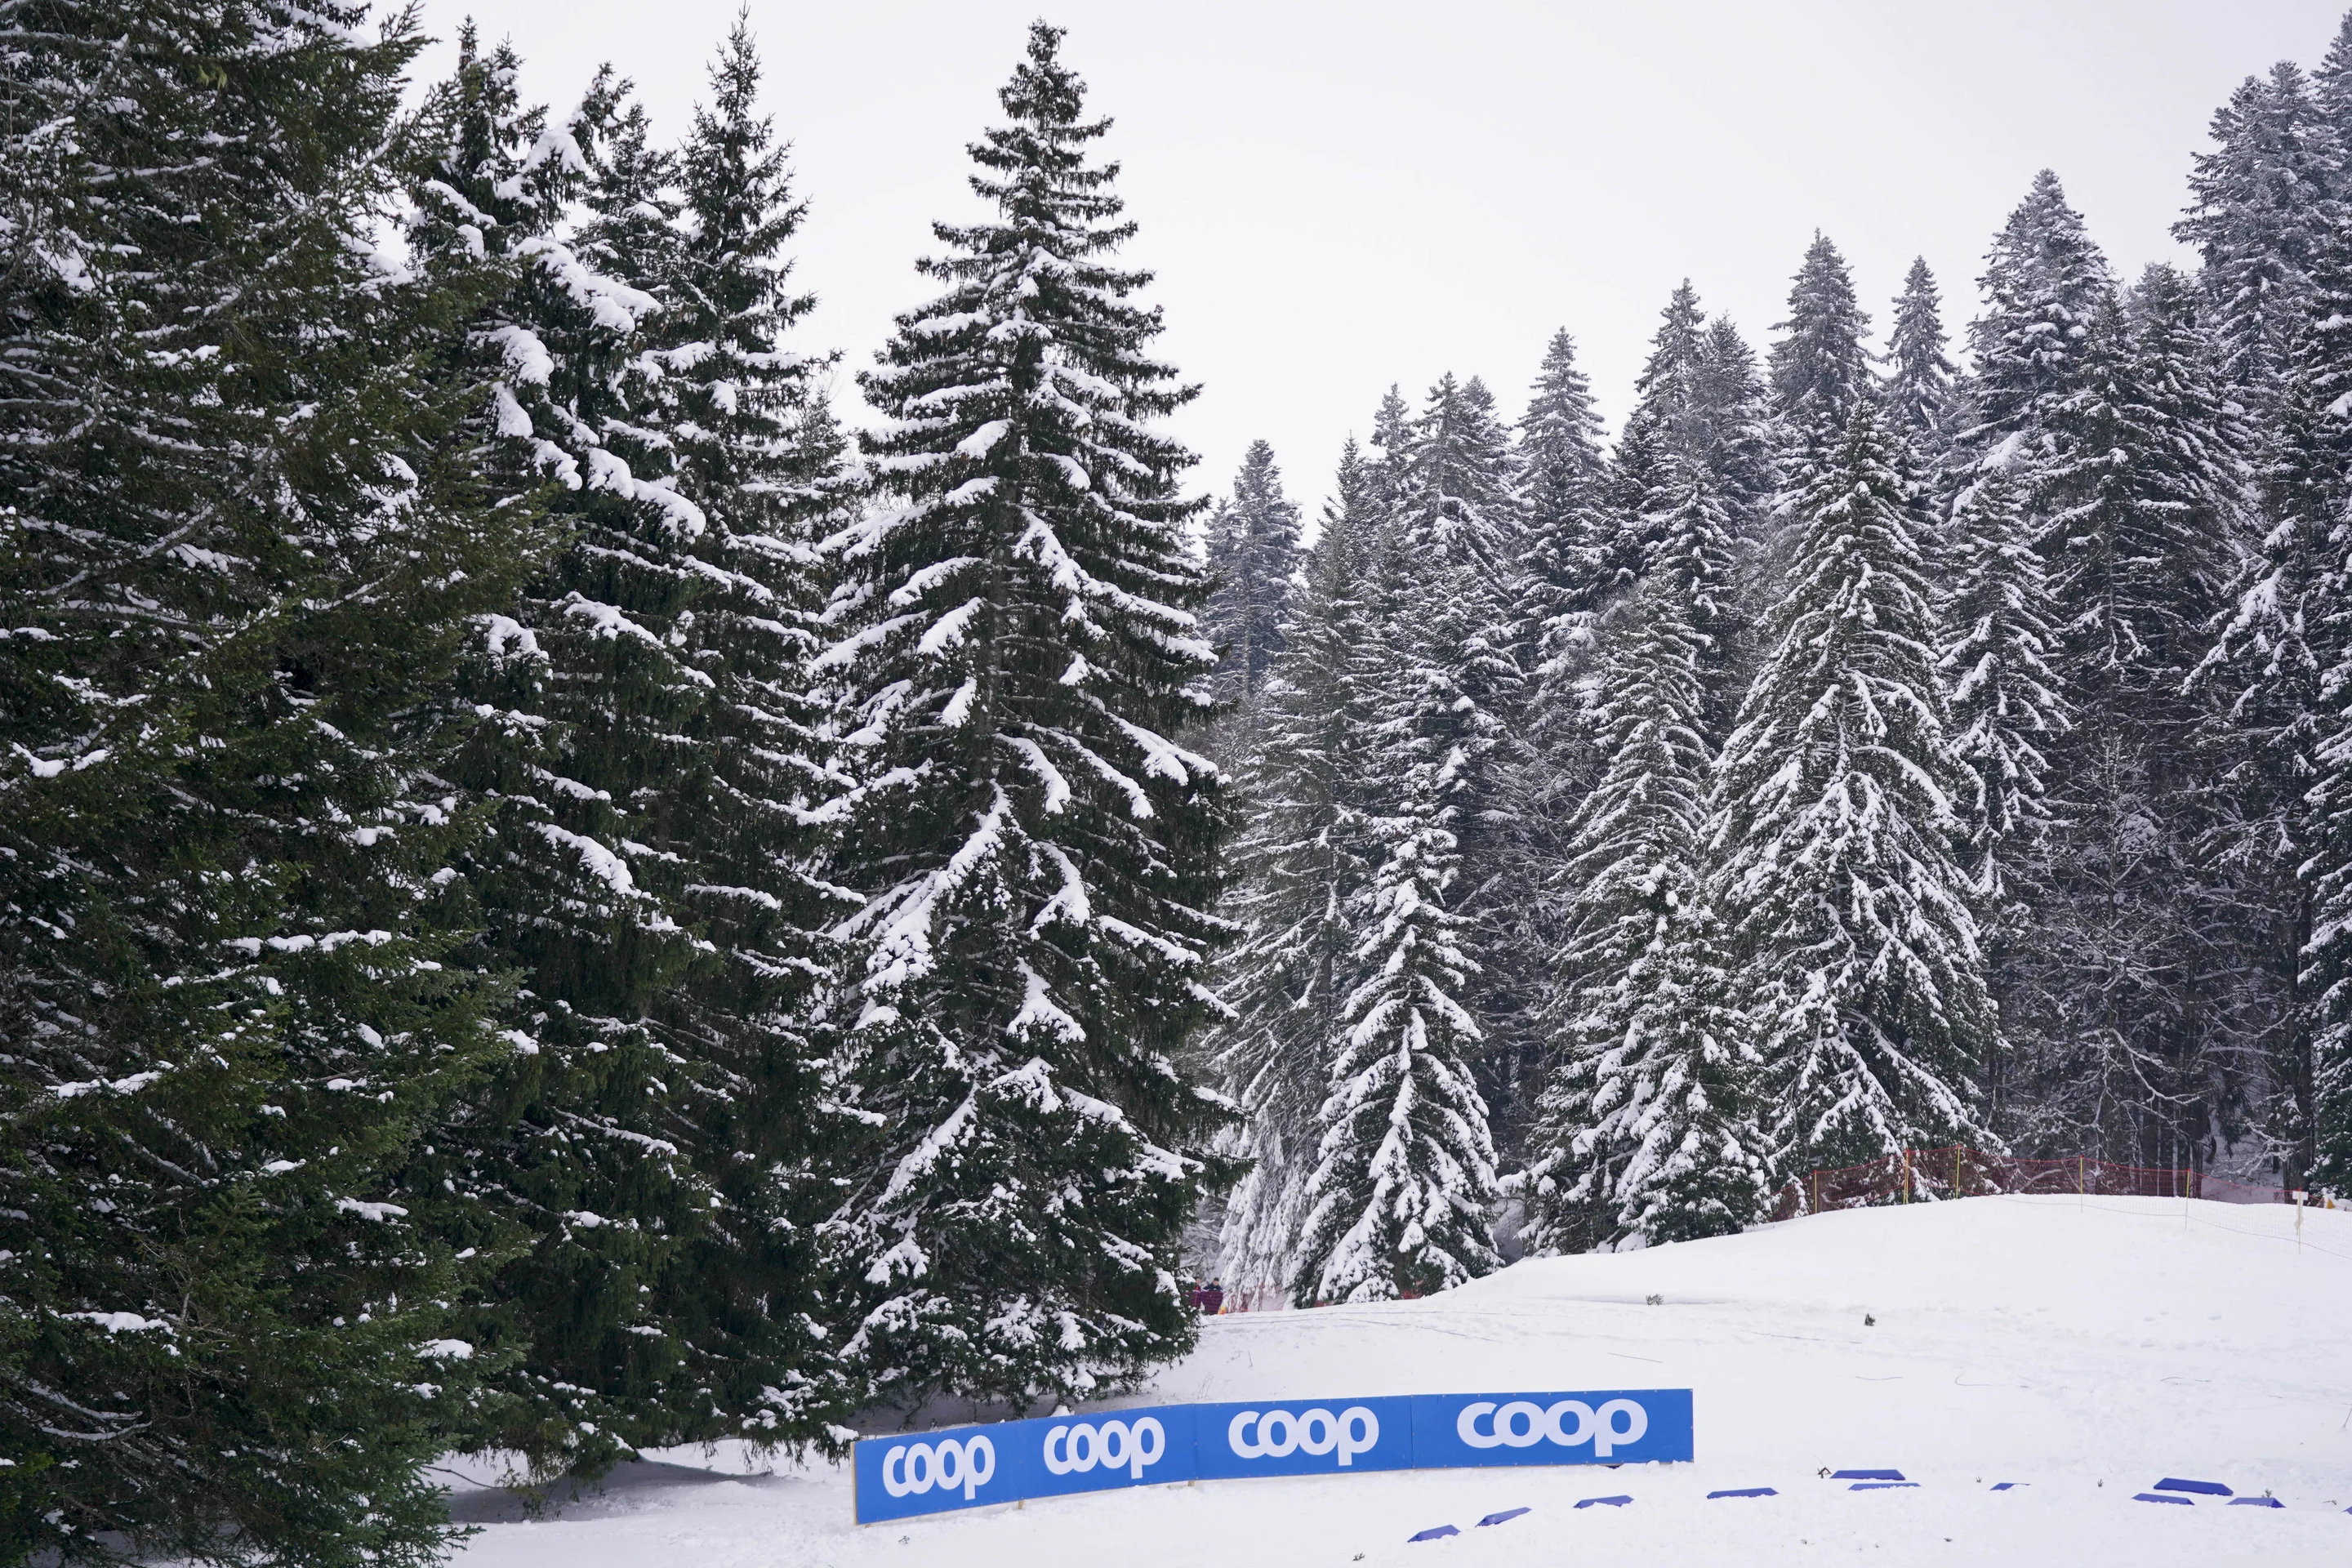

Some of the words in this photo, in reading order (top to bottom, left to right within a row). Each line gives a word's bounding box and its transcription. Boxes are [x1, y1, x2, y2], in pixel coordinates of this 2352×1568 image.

[1043, 1416, 1165, 1480] coop
[1227, 1405, 1379, 1467] coop
[1456, 1398, 1648, 1458] coop
[882, 1435, 996, 1500] coop
